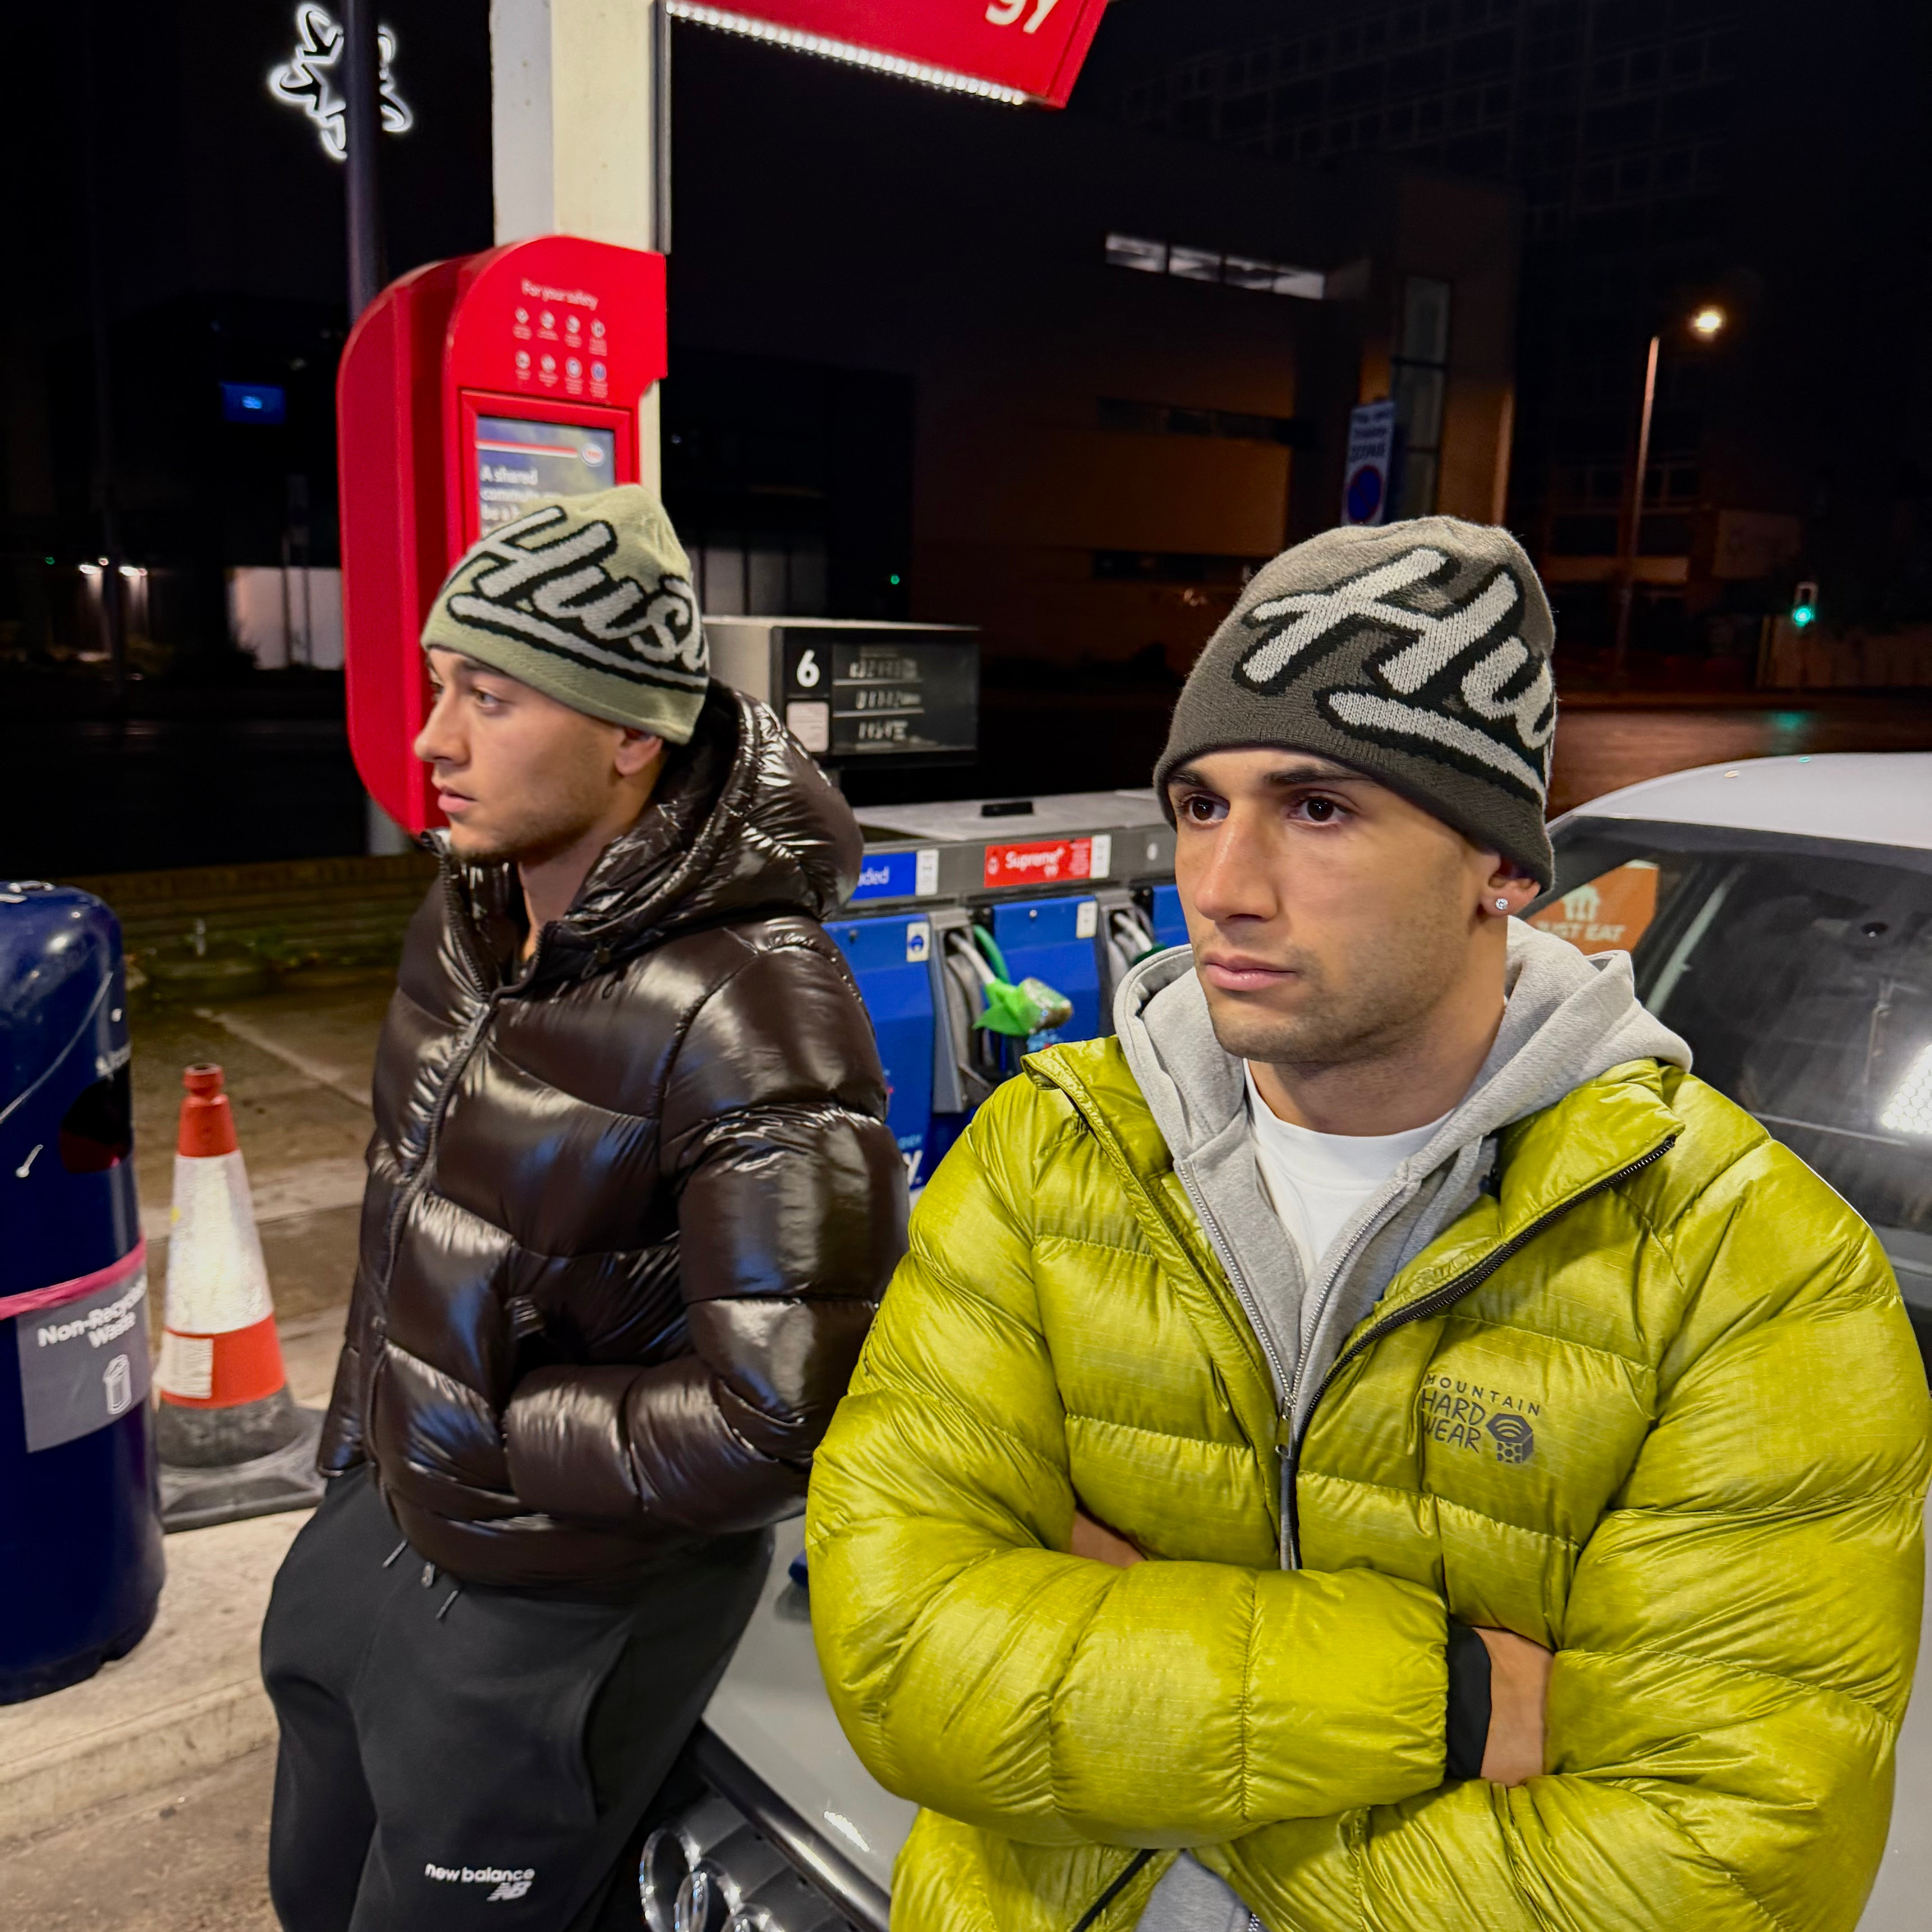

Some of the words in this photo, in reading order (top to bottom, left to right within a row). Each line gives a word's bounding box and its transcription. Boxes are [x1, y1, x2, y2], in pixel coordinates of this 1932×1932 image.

[494, 466, 538, 486] shared
[796, 649, 820, 687] 6
[1421, 1388, 1486, 1426] HARD
[1424, 1373, 1540, 1416] MOUNTAIN
[424, 1863, 460, 1881] new
[461, 1866, 535, 1883] balance
